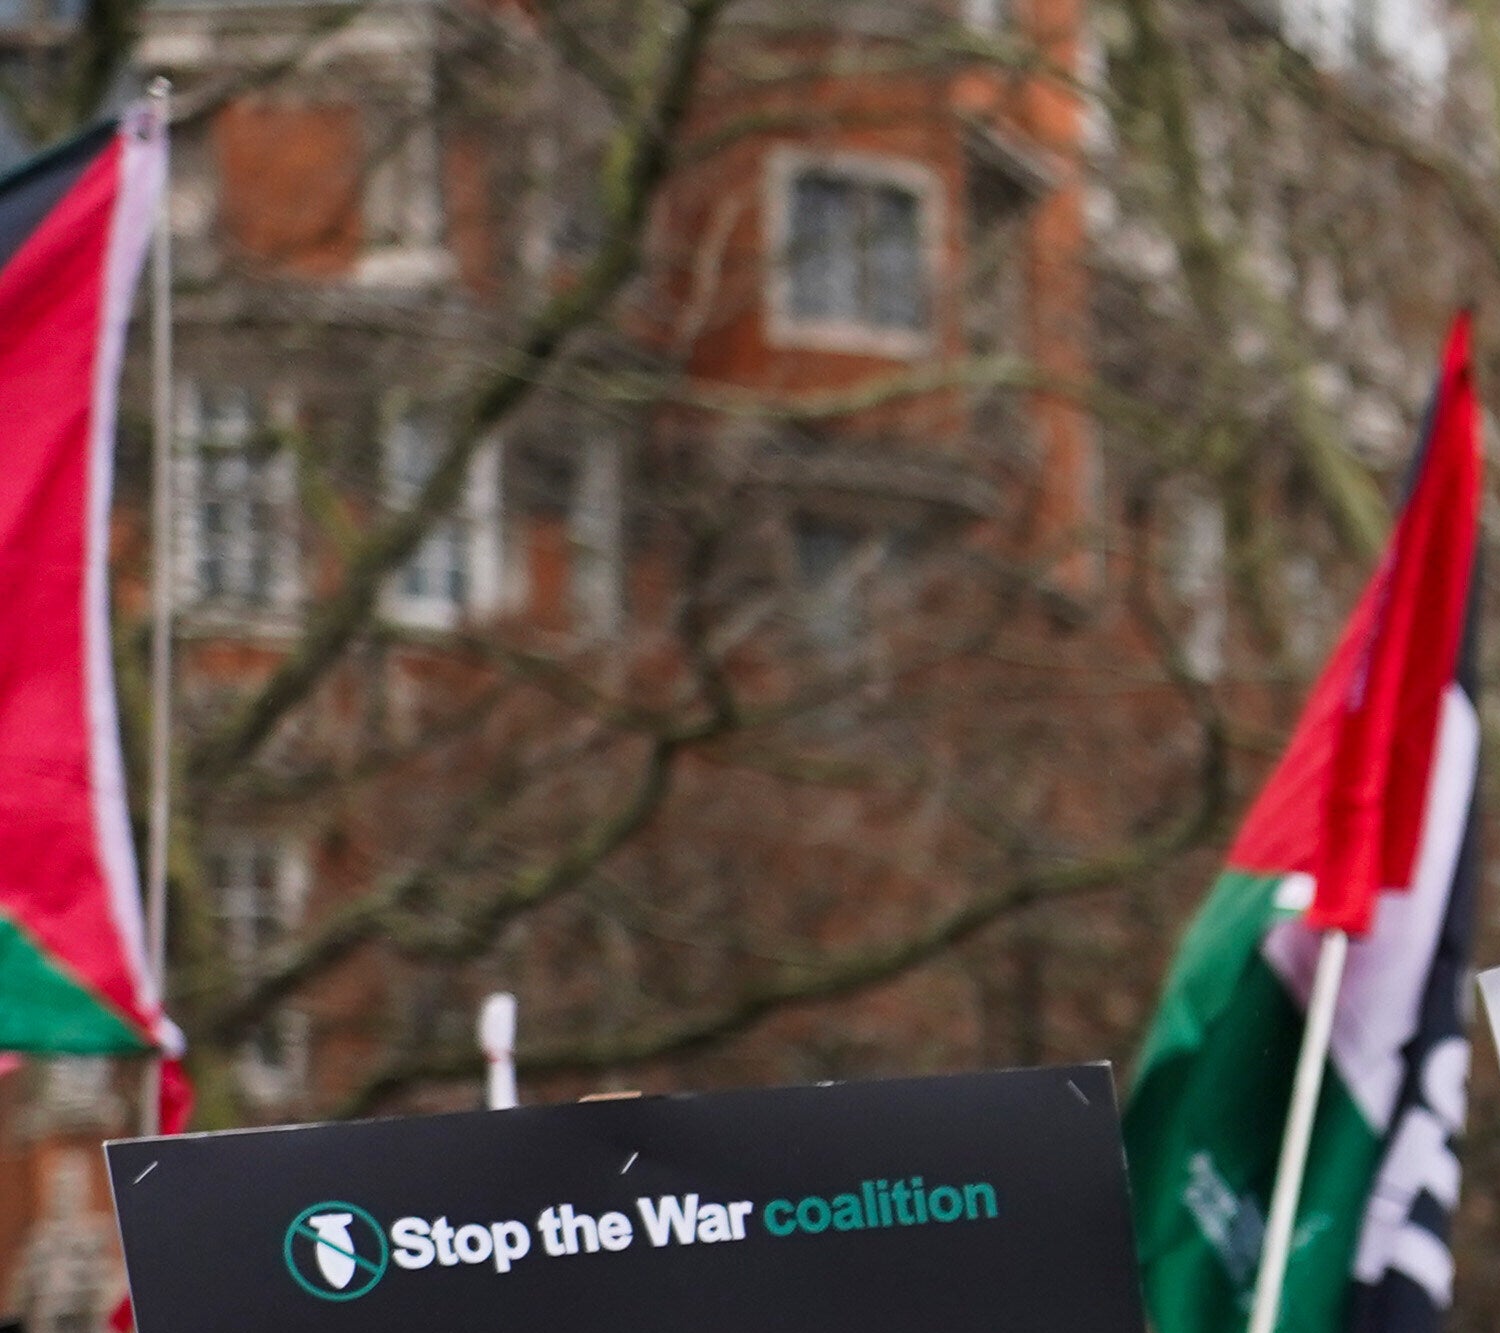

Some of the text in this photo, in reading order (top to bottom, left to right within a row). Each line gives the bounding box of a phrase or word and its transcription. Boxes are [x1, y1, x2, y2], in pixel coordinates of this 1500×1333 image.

[390, 1176, 999, 1273] Stop the War coalition
